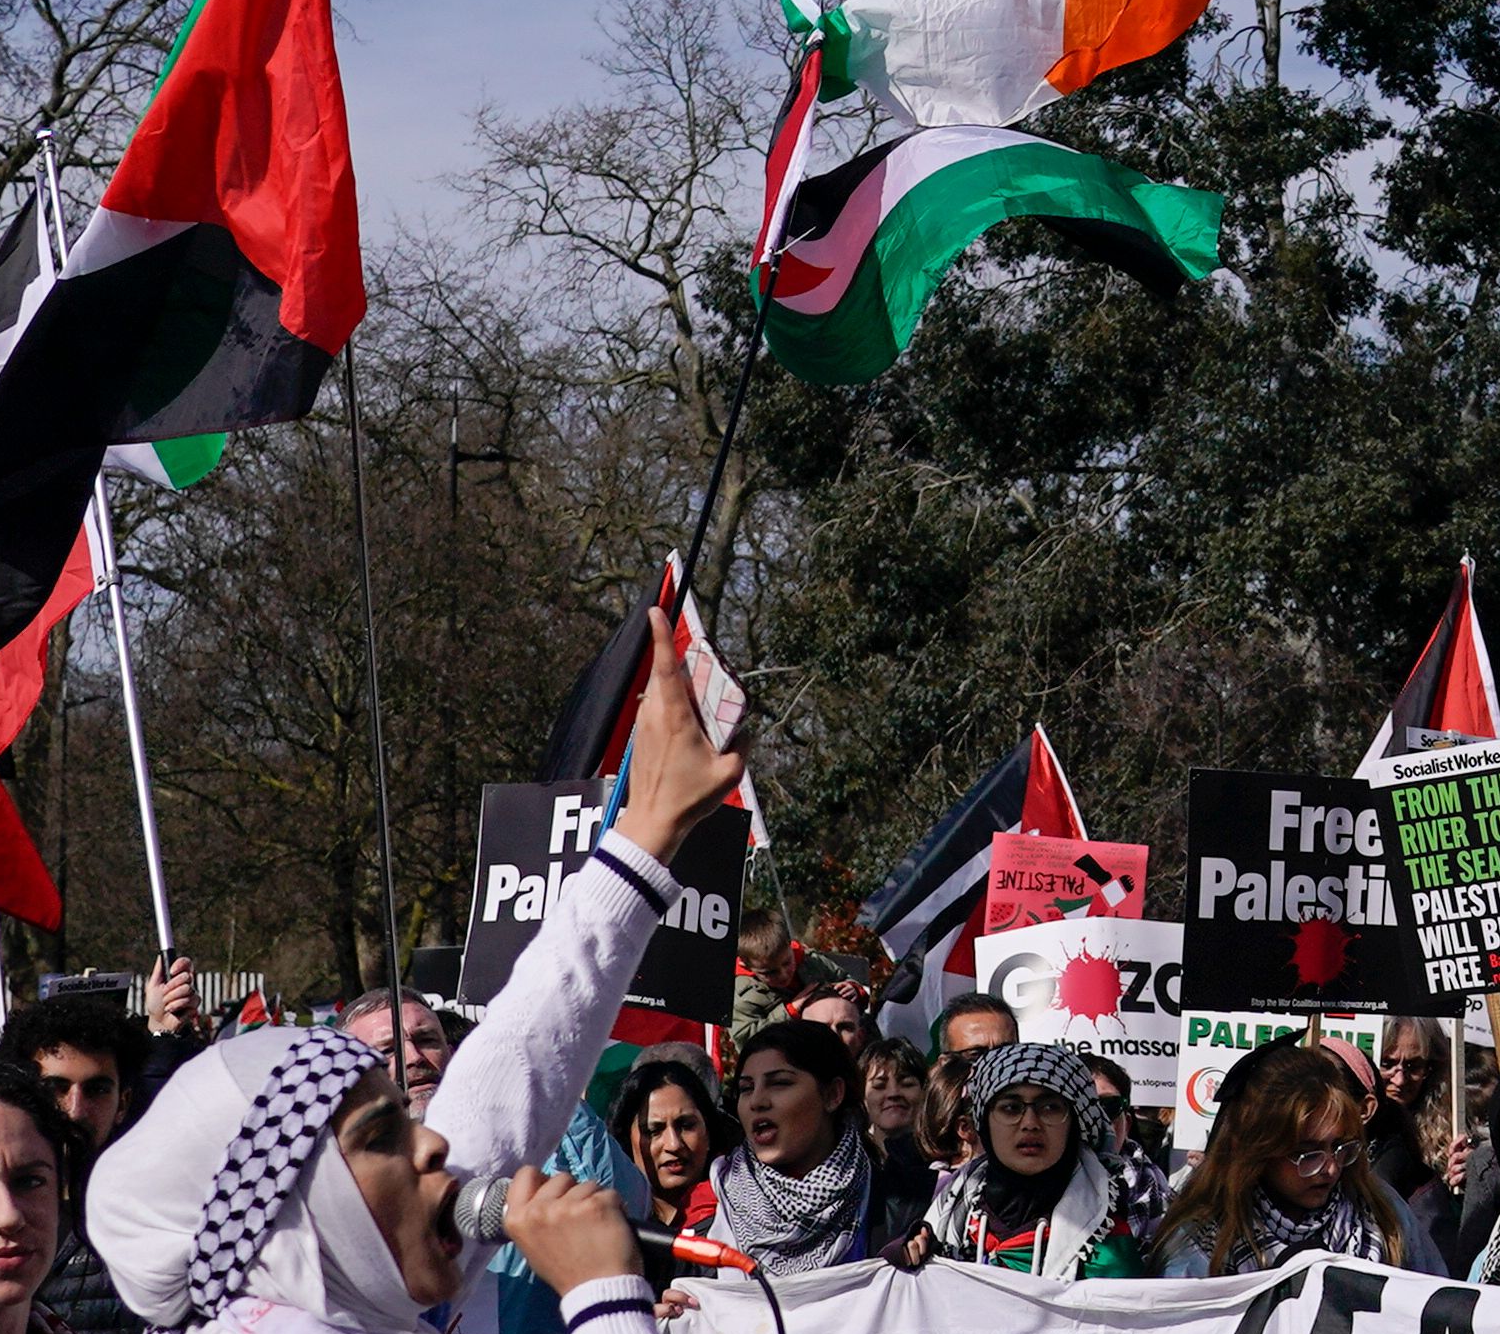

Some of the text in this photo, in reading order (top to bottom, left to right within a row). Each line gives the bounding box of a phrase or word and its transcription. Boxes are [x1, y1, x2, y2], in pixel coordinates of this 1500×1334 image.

[1393, 756, 1454, 780] Socialist
[1391, 780, 1462, 822] FROM
[1269, 789, 1385, 857] Free
[1398, 817, 1470, 856] RIVER
[996, 870, 1085, 896] PALESTINE
[1404, 855, 1454, 890] THE
[1417, 921, 1479, 959] WILL
[1424, 955, 1486, 994] FREE
[1101, 1038, 1179, 1057] massa
